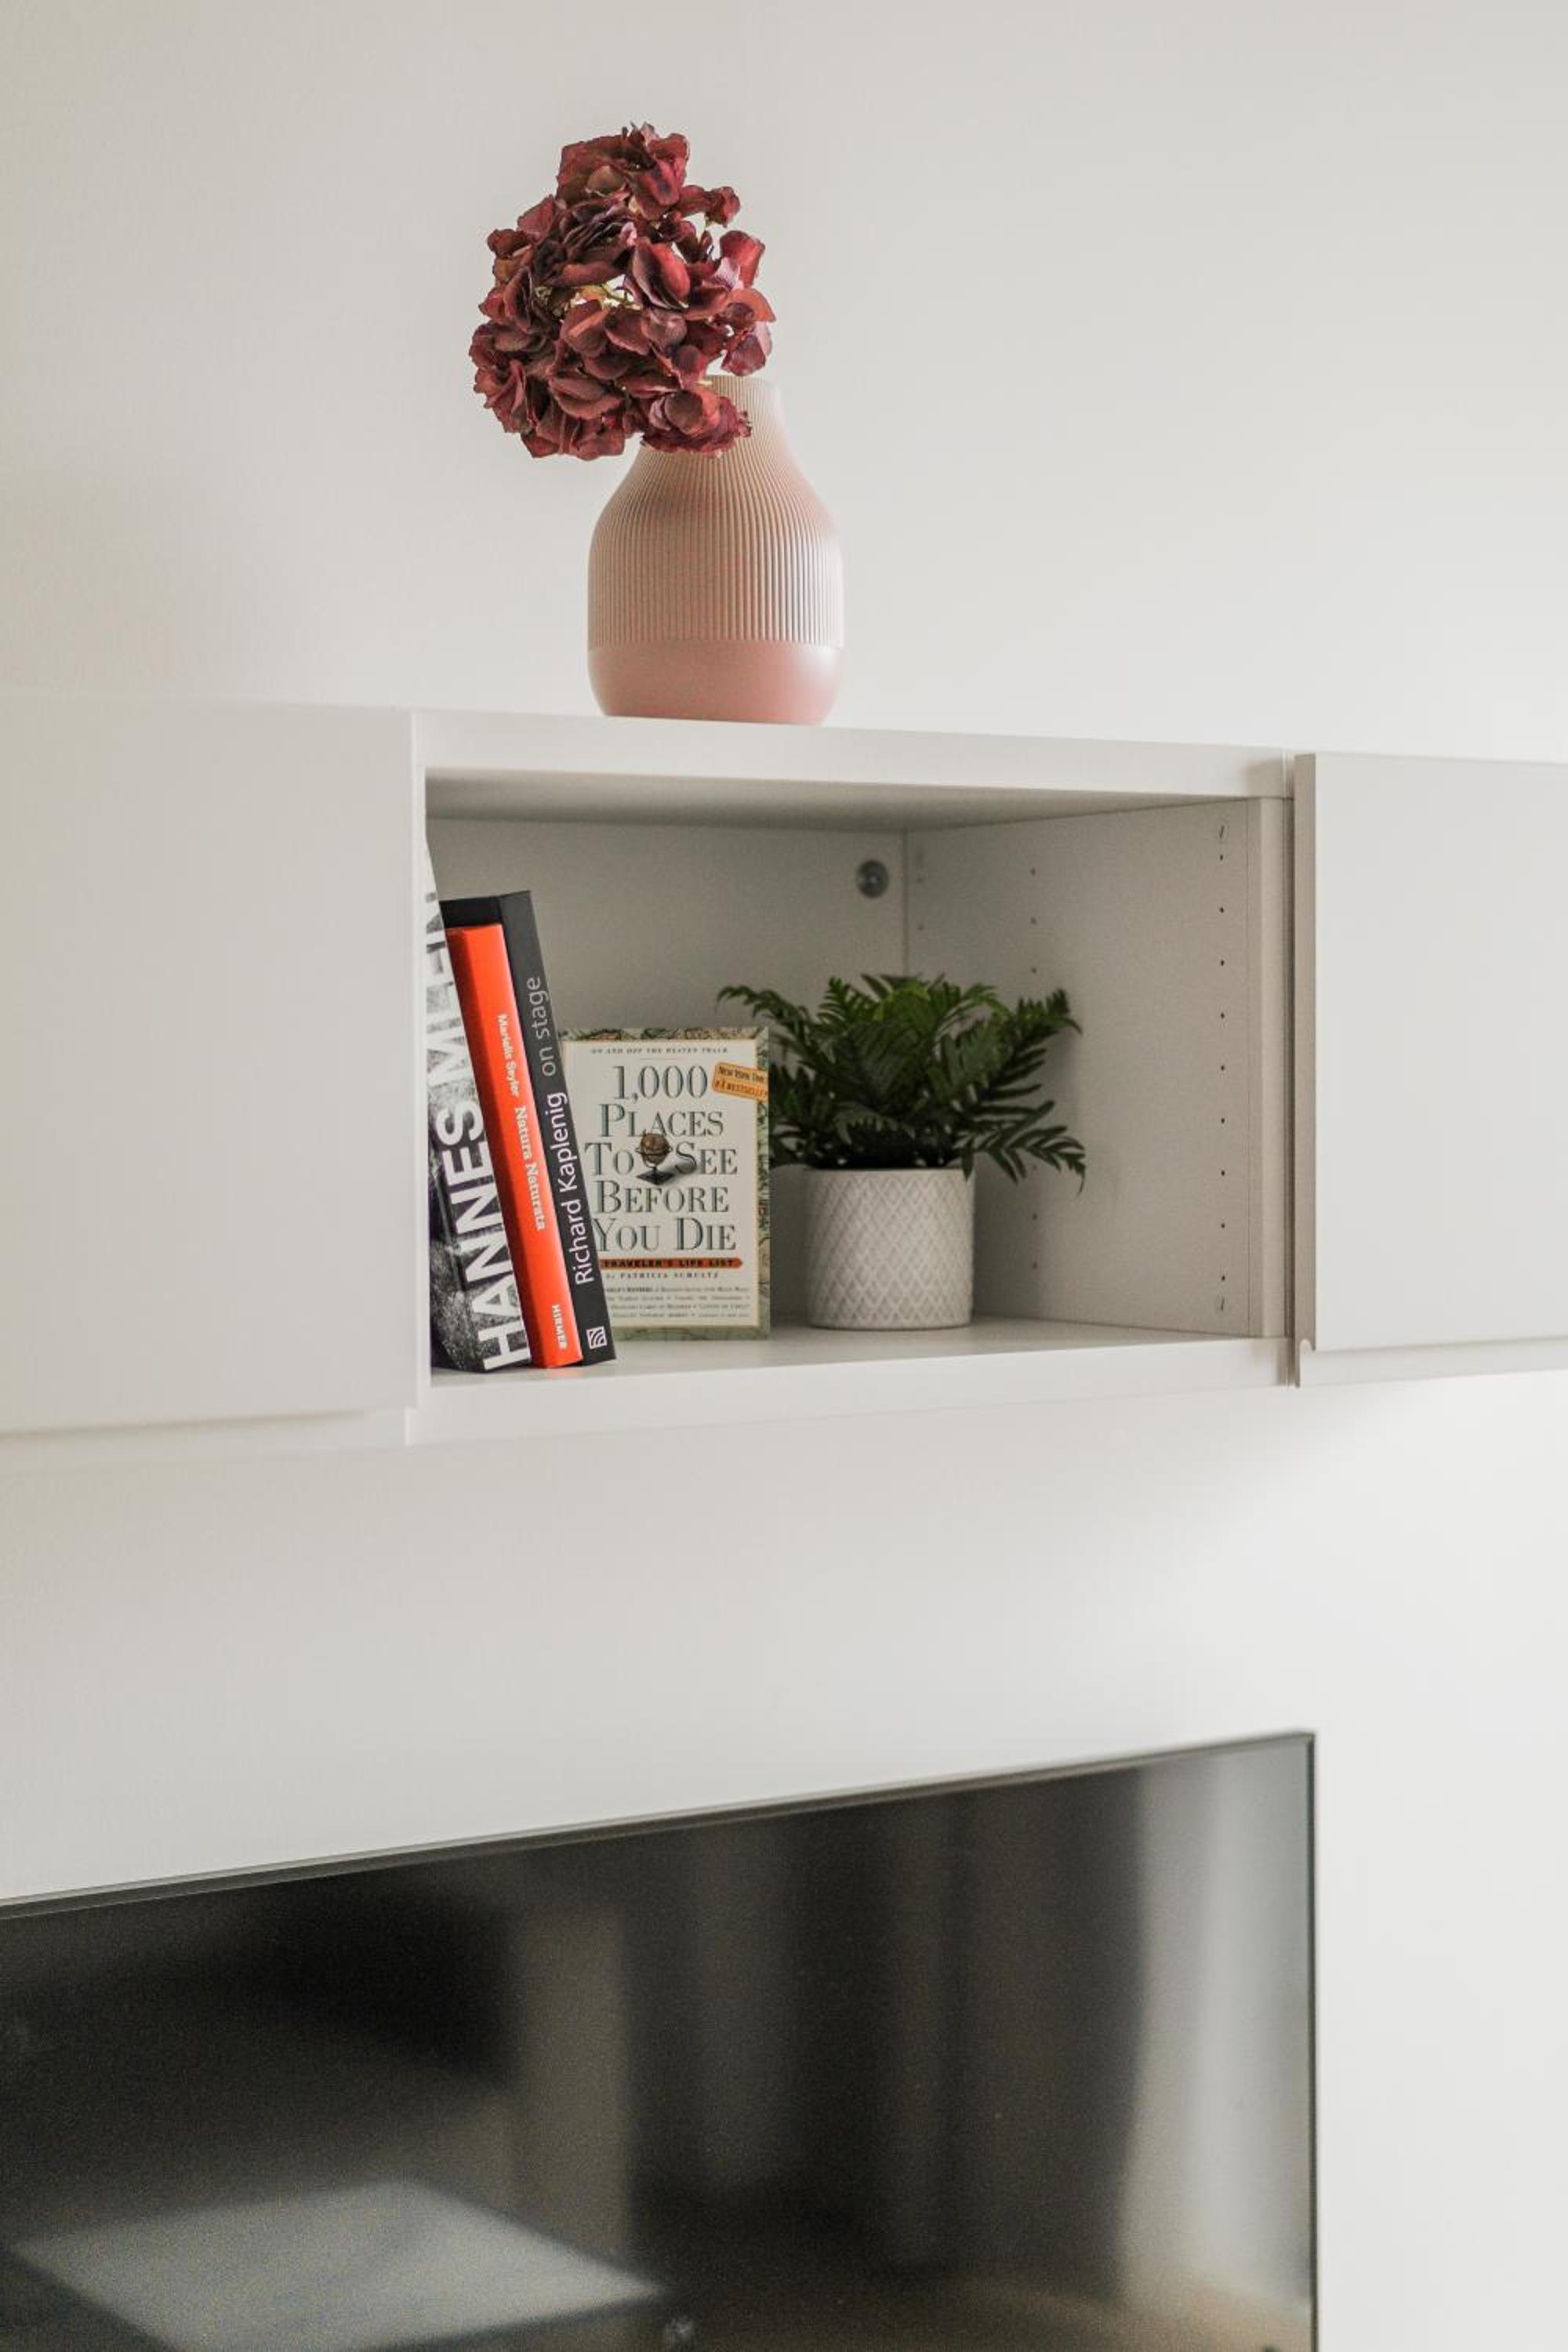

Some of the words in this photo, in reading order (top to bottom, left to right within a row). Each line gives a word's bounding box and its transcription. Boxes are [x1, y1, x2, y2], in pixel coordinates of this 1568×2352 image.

[526, 977, 550, 1040] stage
[539, 1047, 556, 1076] on
[612, 1065, 708, 1104] 1,000
[599, 1103, 724, 1138] PLACES
[545, 1092, 578, 1192] Kaplenig
[585, 1142, 635, 1175] TO
[675, 1142, 738, 1175] SEE
[596, 1180, 729, 1214] BEFORE
[436, 1101, 532, 1370] HANNES
[560, 1199, 594, 1285] Richard
[592, 1218, 660, 1252] YOU
[675, 1217, 736, 1250] DIE
[708, 1259, 734, 1268] LIST
